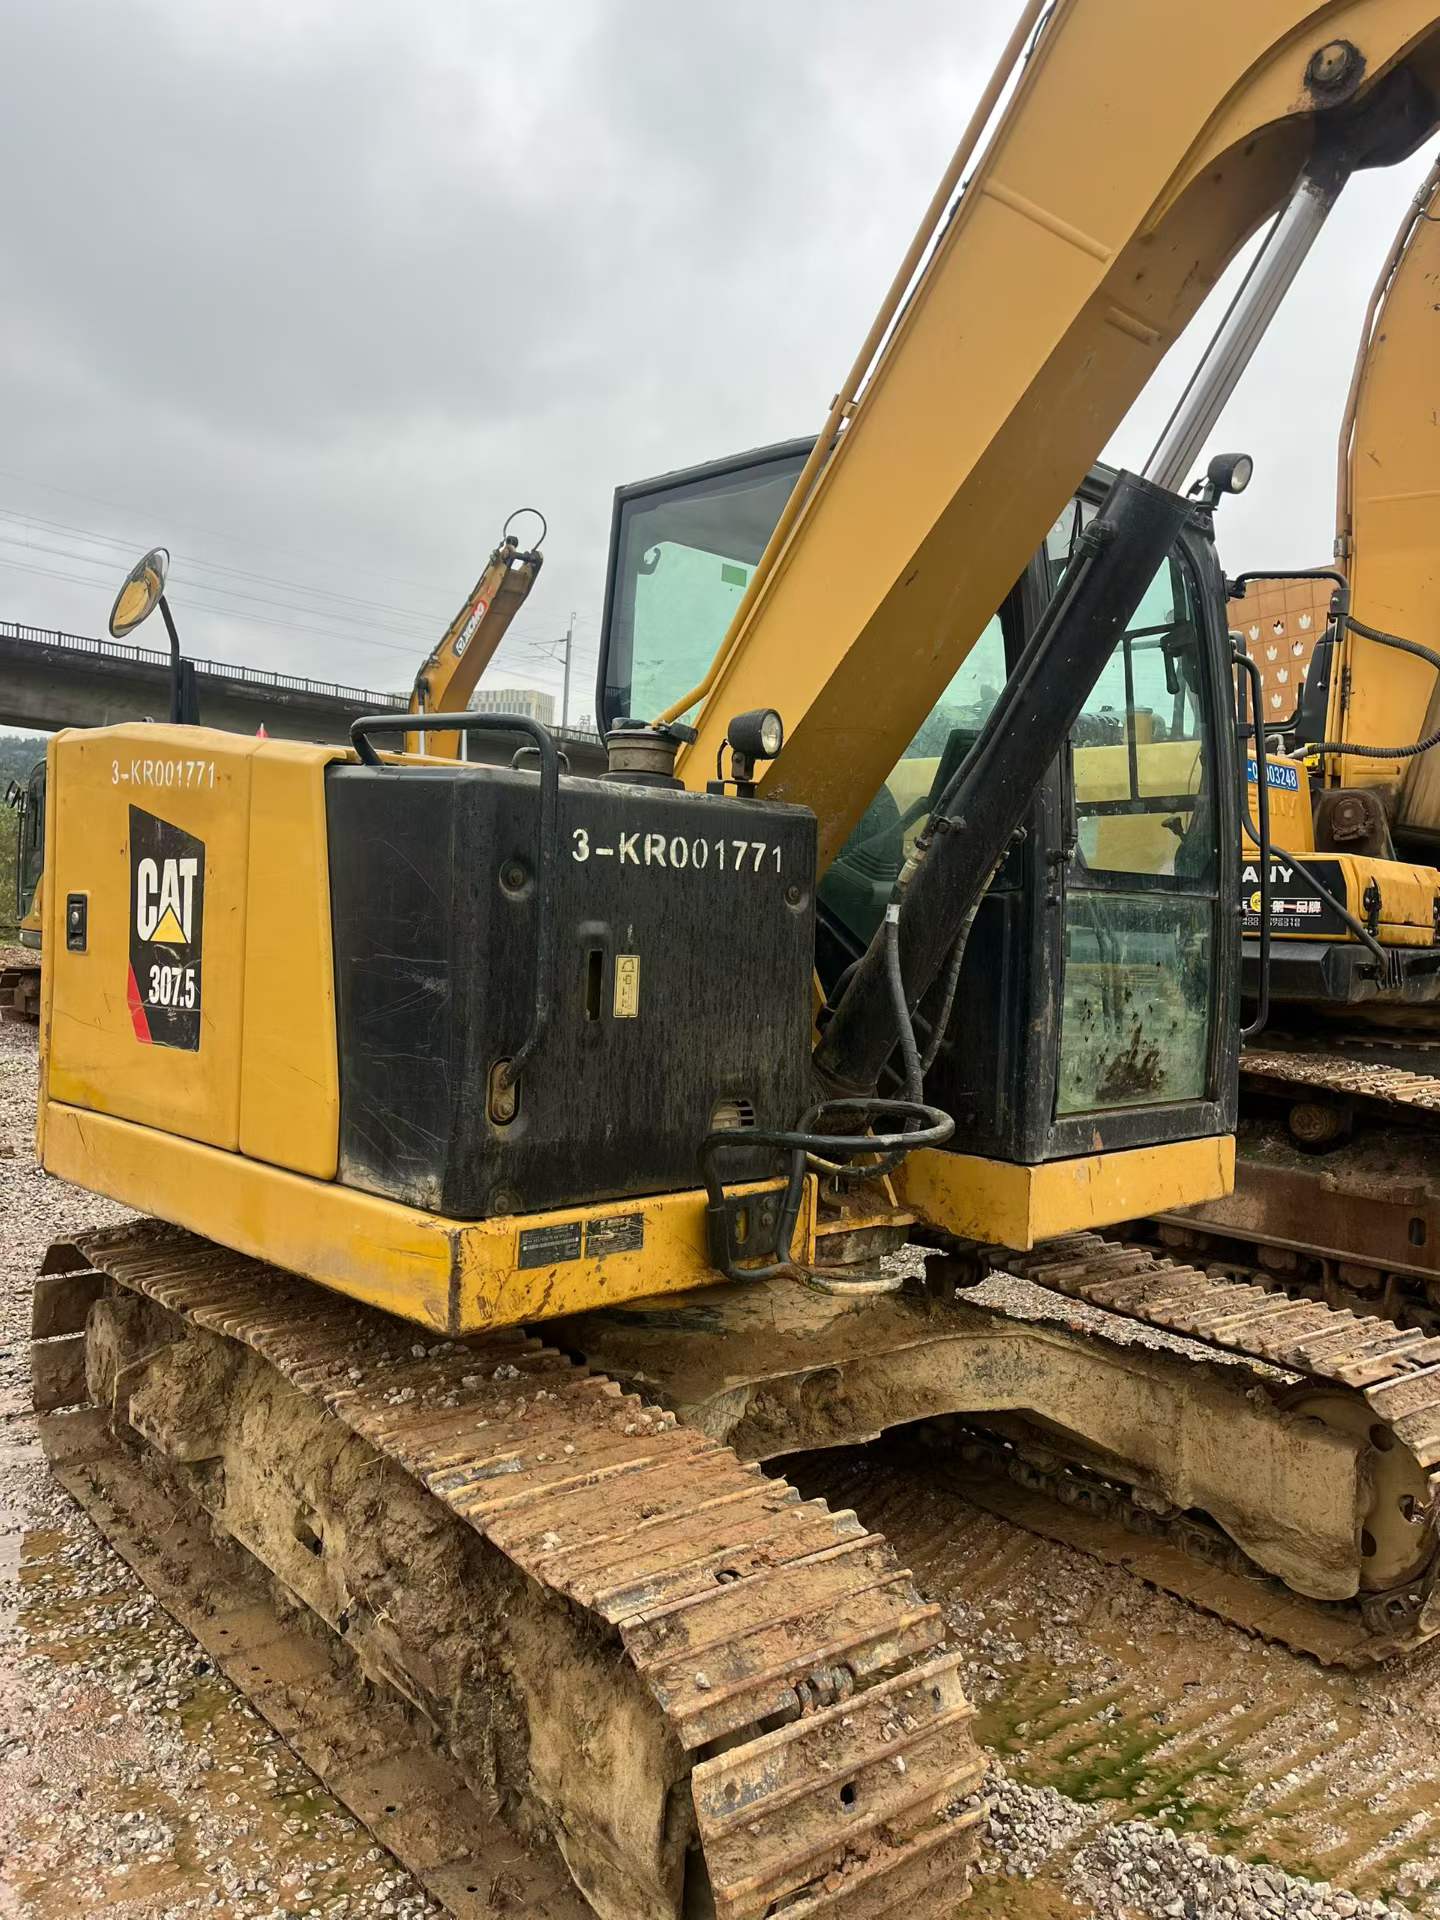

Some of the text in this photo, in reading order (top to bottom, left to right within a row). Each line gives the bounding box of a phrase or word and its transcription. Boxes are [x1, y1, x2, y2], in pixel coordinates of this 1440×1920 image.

[111, 760, 216, 789] 3-KR001771
[572, 828, 783, 874] 3-KR001771
[136, 857, 198, 945] CAT
[148, 964, 195, 1009] 307.5
